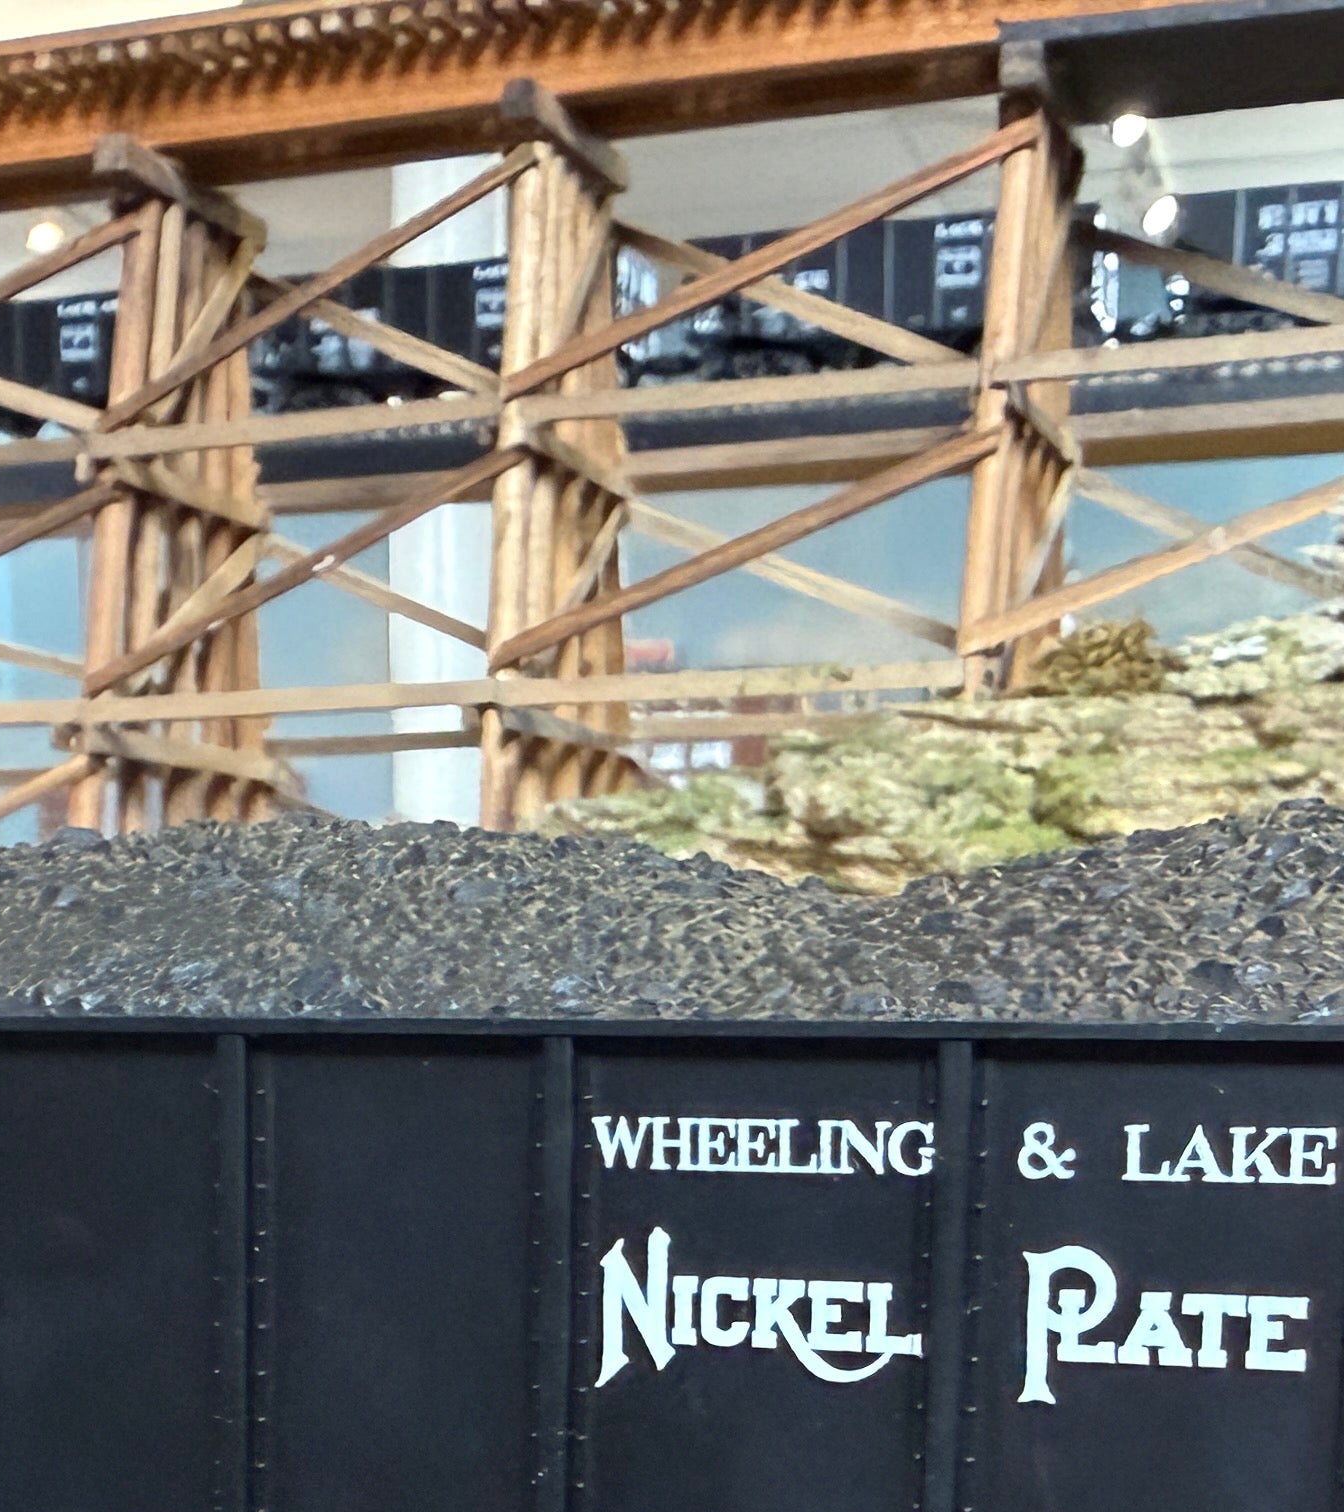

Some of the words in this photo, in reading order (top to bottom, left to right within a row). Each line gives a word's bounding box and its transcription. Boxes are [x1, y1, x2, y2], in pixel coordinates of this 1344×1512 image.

[591, 1115, 936, 1177] WHEELING
[1017, 1121, 1077, 1180] &
[1121, 1123, 1338, 1186] LAKE
[594, 1226, 924, 1388] NICKEL
[1016, 1245, 1311, 1405] PLATE
